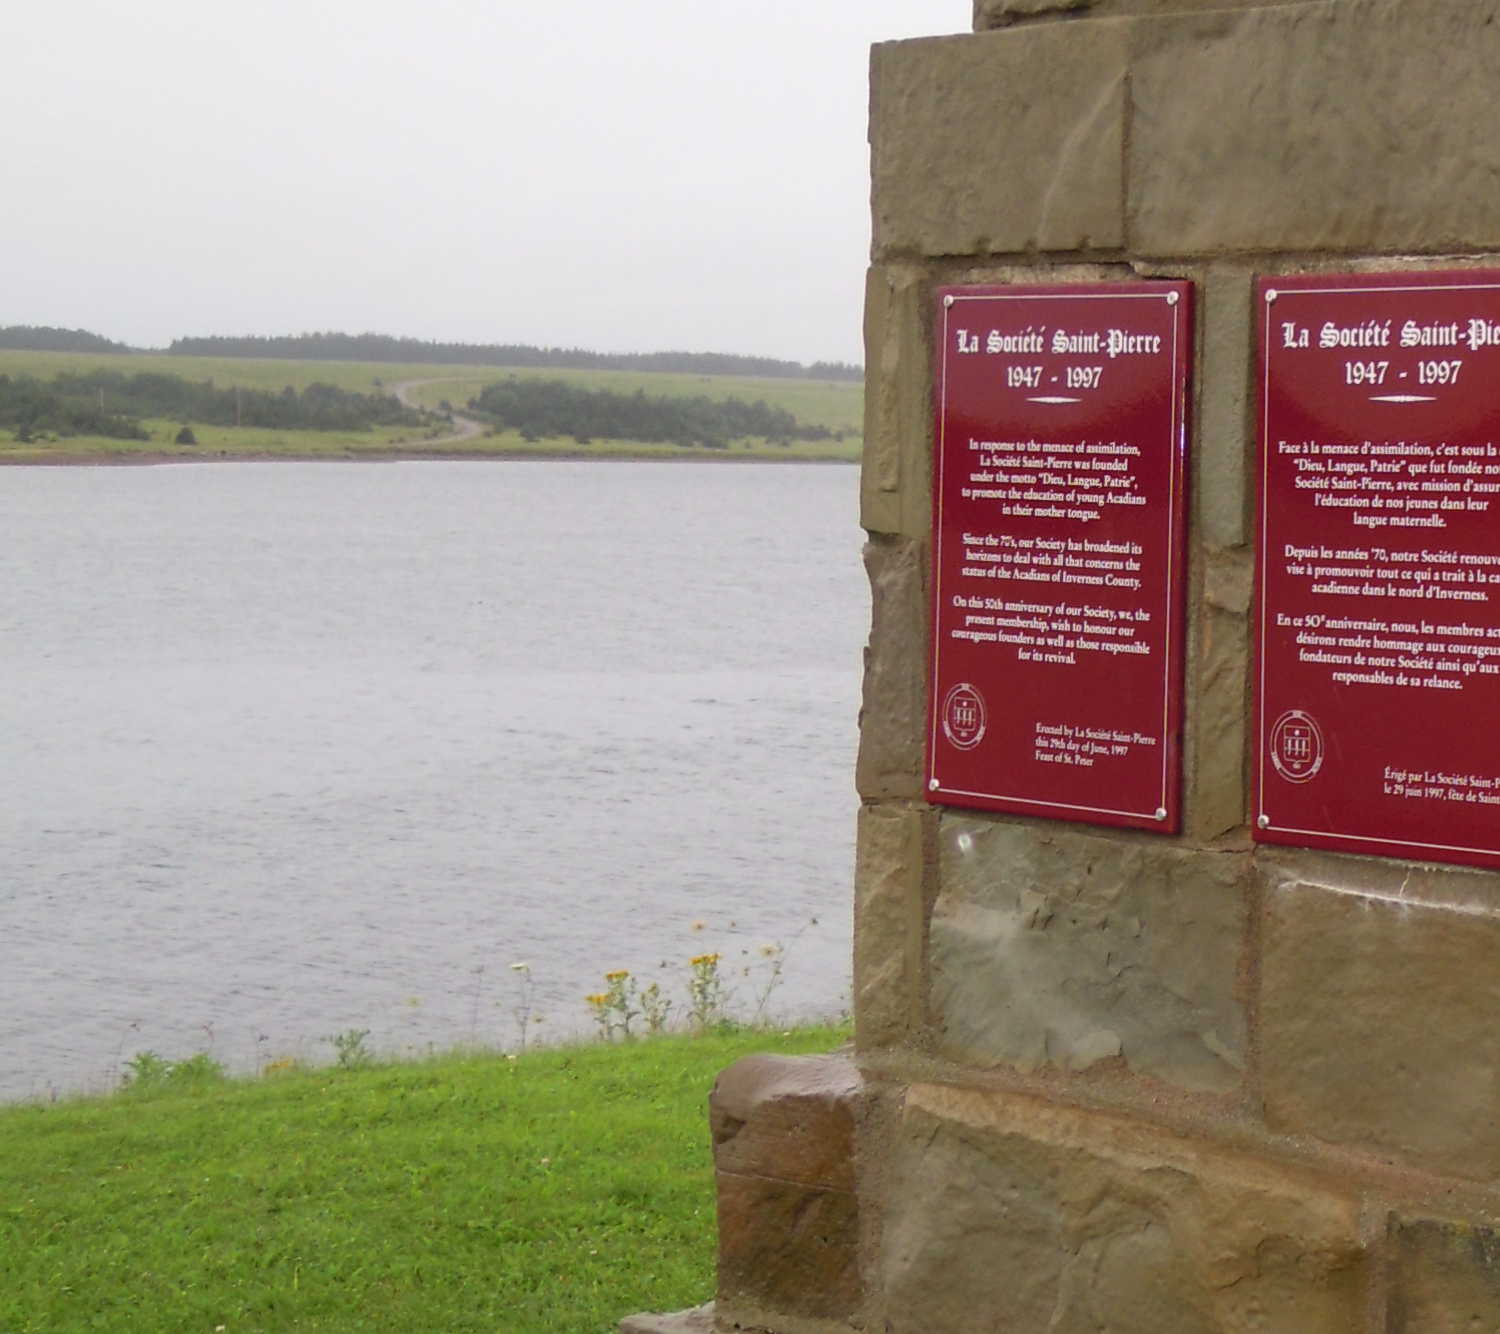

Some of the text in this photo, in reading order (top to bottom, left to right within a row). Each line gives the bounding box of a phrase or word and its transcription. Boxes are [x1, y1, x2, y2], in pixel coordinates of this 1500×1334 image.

[956, 325, 1160, 358] La Société Saint-Pierre
[1281, 322, 1309, 348] La
[1319, 319, 1391, 348] Société
[1007, 366, 1043, 387] 1947
[1066, 366, 1103, 388] 1997
[1345, 361, 1389, 384] 1947
[1417, 360, 1462, 384] 1997
[1278, 440, 1301, 453] Face
[1302, 441, 1309, 453] à
[1310, 440, 1320, 454] la
[1321, 444, 1359, 454] menace
[1461, 446, 1485, 456] sous
[1486, 442, 1497, 456] la
[1327, 458, 1368, 475] Langue,
[1407, 463, 1428, 477] que
[1429, 459, 1445, 473] fut
[1447, 459, 1483, 474] fondée
[1294, 475, 1330, 489] Société
[1330, 476, 1394, 492] Saint-Pierre,
[1396, 481, 1419, 491] avec
[1421, 478, 1461, 491] mission
[1371, 494, 1384, 507] de
[1385, 498, 1404, 508] nos
[1405, 495, 1439, 511] jeunes
[1440, 495, 1465, 510] dans
[1466, 496, 1489, 510] leur
[1353, 511, 1447, 528] langue maternelle.
[1284, 544, 1319, 561] Depuis
[1320, 545, 1333, 558] les
[1335, 547, 1369, 560] années
[1390, 551, 1419, 562] notre
[1421, 549, 1458, 563] Société
[1286, 562, 1305, 574] vise
[1306, 562, 1313, 575] à
[1314, 564, 1375, 578] promouvoir
[1376, 567, 1399, 579] tout
[1400, 570, 1412, 579] ce
[1413, 567, 1431, 583] qui
[1433, 571, 1440, 581] a
[1441, 568, 1466, 582] trait
[1467, 569, 1475, 582] à
[1476, 568, 1487, 583] la
[1311, 578, 1360, 595] acadienne
[1361, 581, 1386, 596] dans
[1387, 582, 1397, 596] le
[1398, 583, 1424, 598] nord
[1277, 612, 1291, 626] En
[1292, 617, 1303, 626] ce
[1325, 615, 1389, 633] anniversaire,
[1390, 622, 1419, 635] nous,
[1420, 619, 1434, 634] les
[1436, 622, 1484, 637] membres
[1296, 630, 1336, 646] désirons
[1338, 634, 1371, 648] rendre
[1373, 634, 1424, 654] hommage
[1425, 642, 1445, 652] aux
[1299, 647, 1352, 664] fondateurs
[1353, 651, 1366, 665] de
[1367, 656, 1396, 667] notre
[1397, 655, 1434, 670] Société
[1435, 657, 1460, 671] ainsi
[1332, 670, 1463, 689] responsables de sa relance.
[1384, 765, 1407, 783] Érigé
[1408, 773, 1423, 783] par
[1424, 771, 1436, 783] La
[1437, 772, 1468, 786] Société
[1384, 781, 1392, 794] le
[1393, 783, 1404, 794] 29
[1405, 784, 1422, 798] juin
[1424, 787, 1446, 800] 1997,
[1465, 789, 1477, 802] de
[1478, 791, 1500, 804] Saint
